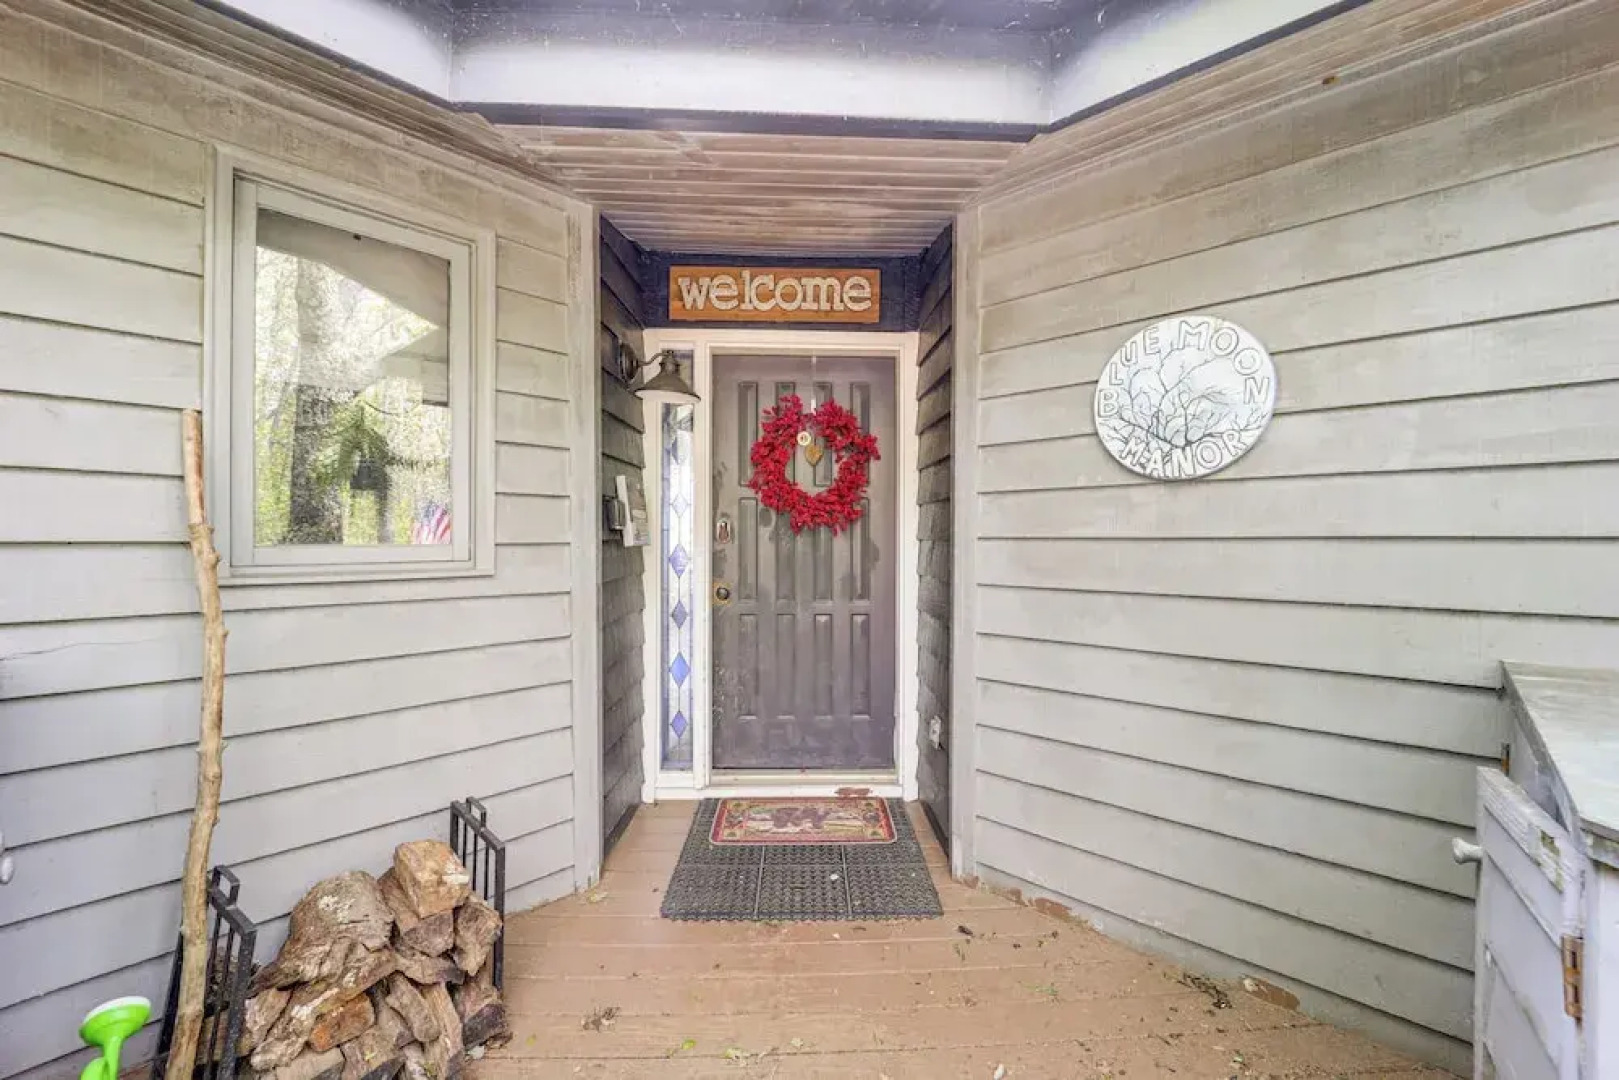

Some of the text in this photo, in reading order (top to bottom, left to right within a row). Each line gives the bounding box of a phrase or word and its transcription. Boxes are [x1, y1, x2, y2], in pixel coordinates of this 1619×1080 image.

[678, 269, 872, 312] welcome
[1099, 320, 1270, 418] BLUE MOON
[1120, 429, 1248, 478] MANOR
